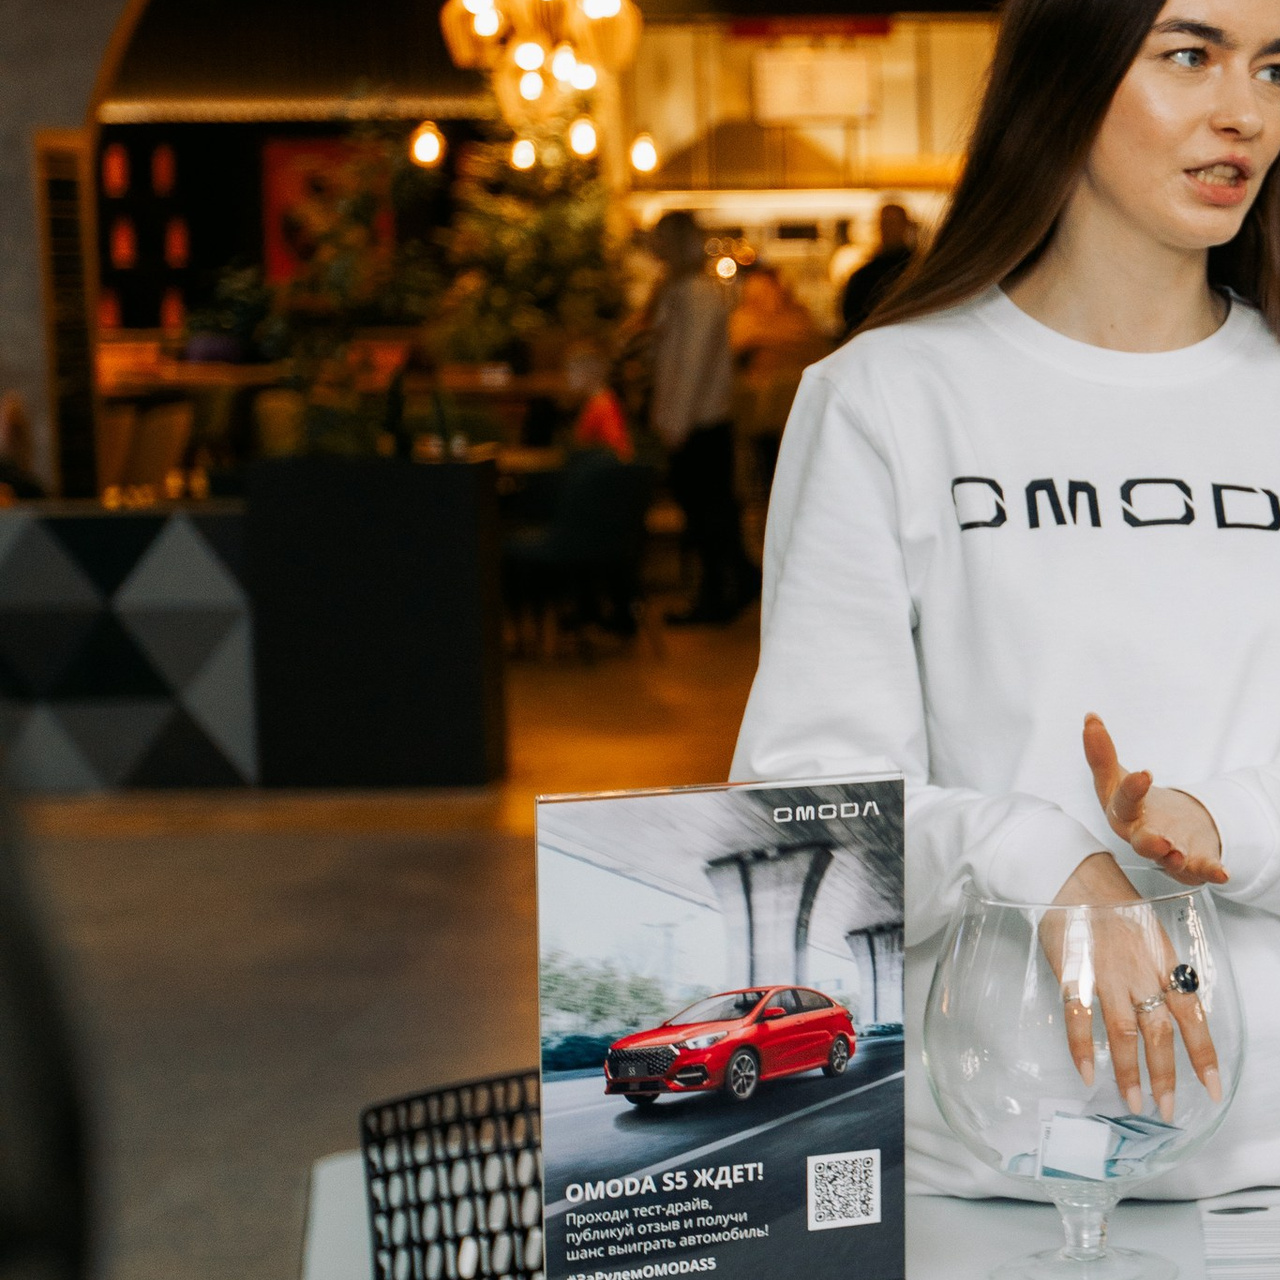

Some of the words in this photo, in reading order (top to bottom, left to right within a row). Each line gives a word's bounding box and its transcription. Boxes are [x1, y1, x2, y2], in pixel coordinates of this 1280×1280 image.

[773, 801, 880, 823] OMODA
[565, 1176, 657, 1203] OMODA
[662, 1171, 688, 1192] S5
[693, 1162, 764, 1190] ЖДЕТ!
[566, 1208, 629, 1228] Проходи
[632, 1197, 713, 1218] тест-драйв,
[566, 1223, 635, 1246] публикуй
[638, 1219, 680, 1235] отзыв
[684, 1219, 693, 1228] и
[696, 1212, 747, 1228] получи
[566, 1245, 605, 1261] шанс
[608, 1239, 676, 1255] выиграть
[679, 1224, 770, 1247] автомобиль!
